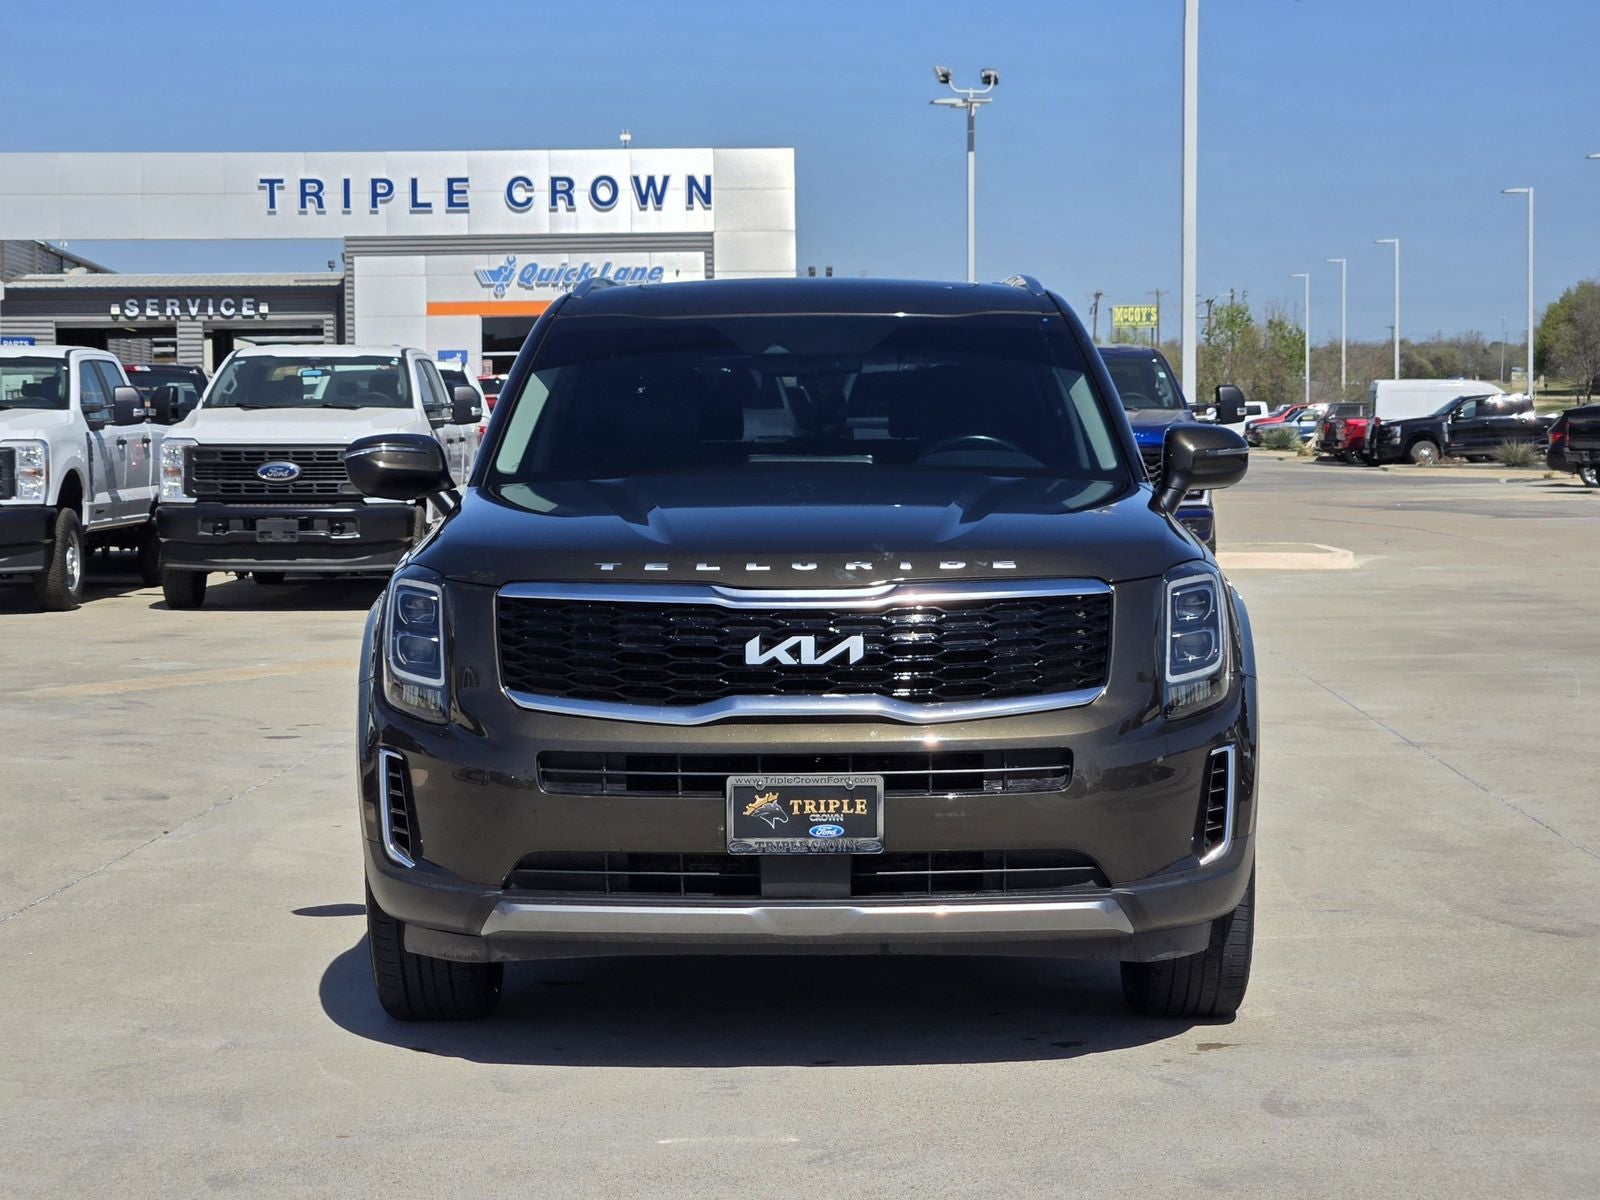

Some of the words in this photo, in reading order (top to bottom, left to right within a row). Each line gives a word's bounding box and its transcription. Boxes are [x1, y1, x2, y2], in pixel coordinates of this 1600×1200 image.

[258, 177, 470, 213] TRIPLE
[505, 174, 712, 211] CROWN
[518, 261, 597, 287] Quick
[600, 261, 665, 282] Lane
[124, 298, 256, 317] SERVICE
[594, 561, 1018, 571] TELLURIDE
[744, 634, 865, 666] KIA
[789, 799, 868, 815] TRIPLE
[809, 813, 844, 822] CROWN
[754, 841, 808, 853] TRIPLE
[810, 840, 859, 853] CROWN
